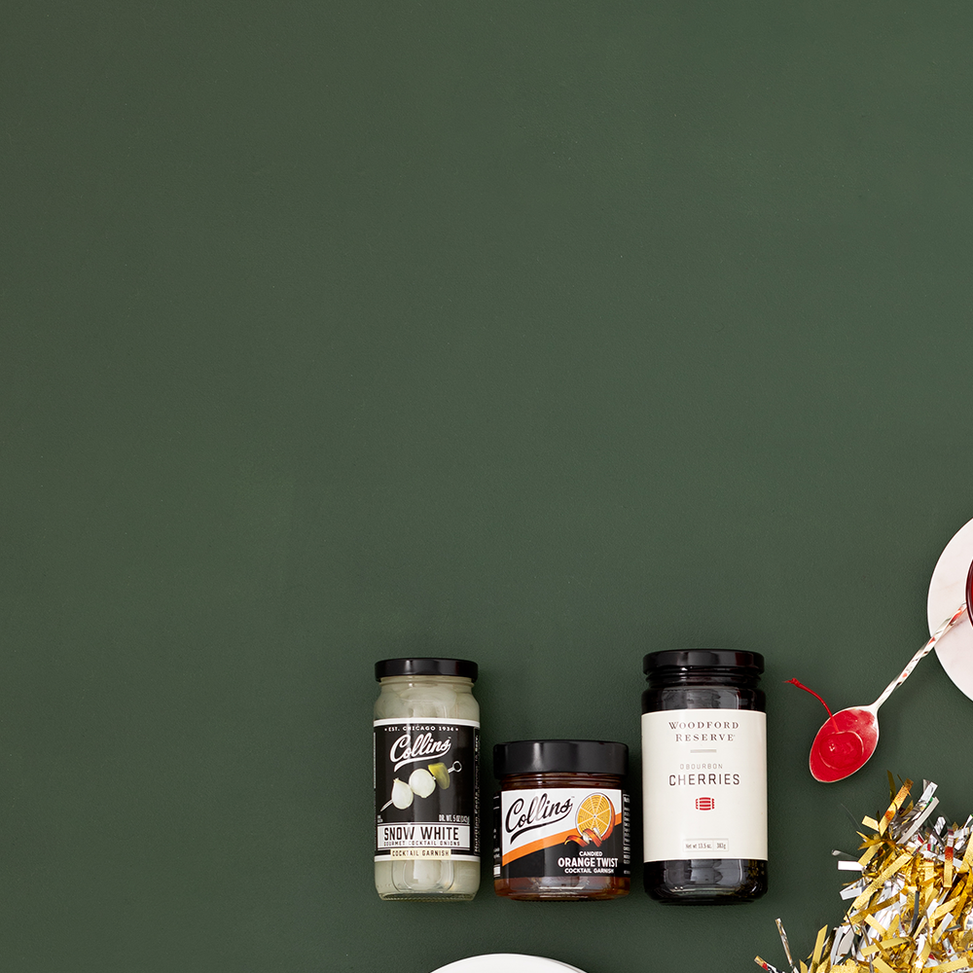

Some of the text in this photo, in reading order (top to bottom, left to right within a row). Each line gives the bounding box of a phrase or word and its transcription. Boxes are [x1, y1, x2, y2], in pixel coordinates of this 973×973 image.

[668, 721, 740, 730] WOODFORD
[675, 733, 735, 742] RESERVE
[390, 732, 452, 772] Collins
[668, 773, 741, 787] CHERRIES
[505, 793, 574, 845] Collins
[383, 826, 459, 841] SNOW WHITE
[421, 849, 449, 857] GARNISH
[557, 857, 619, 868] ORANGE TWIST
